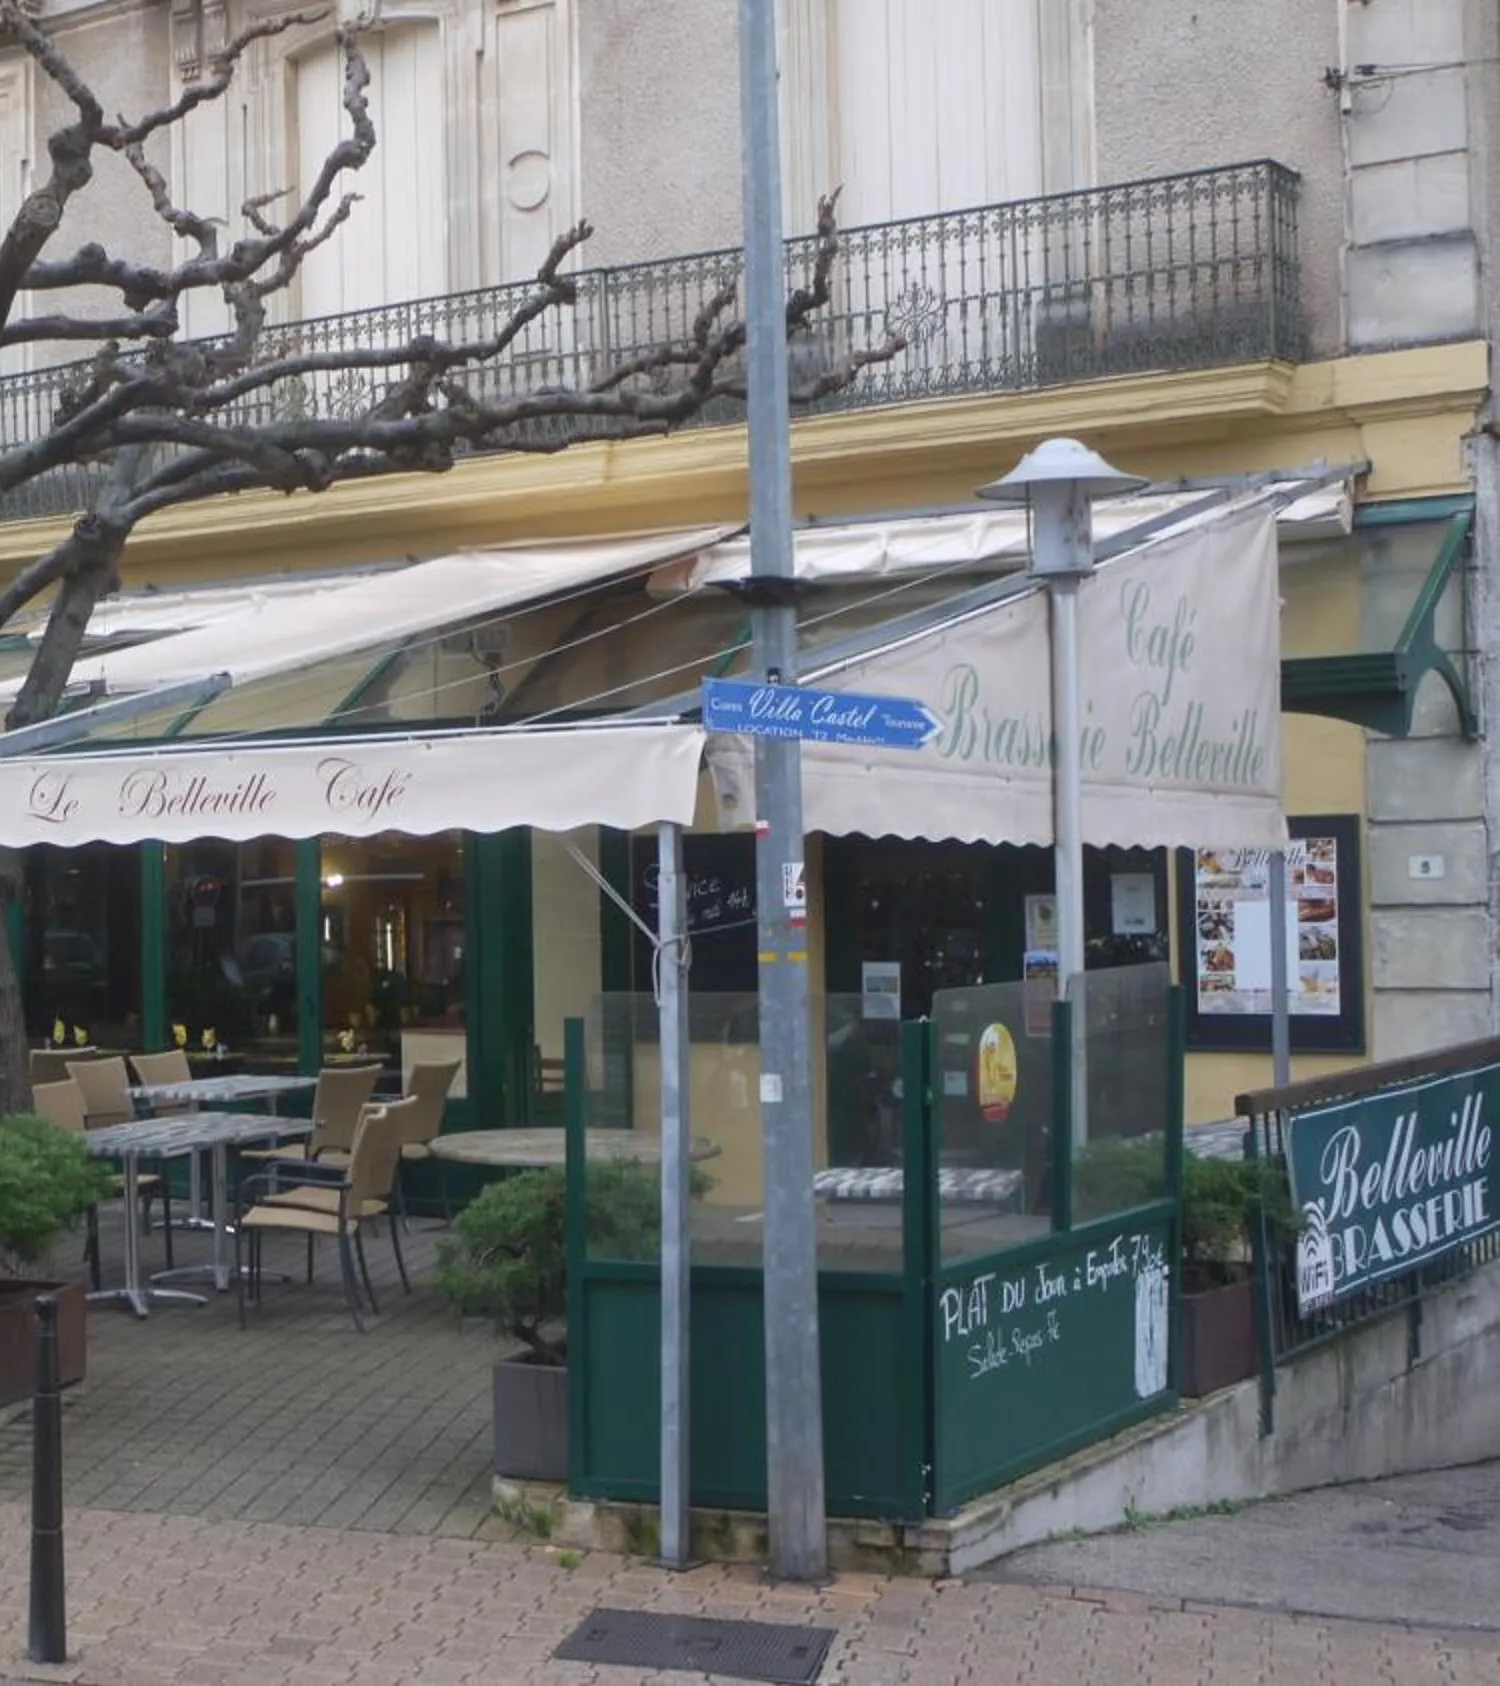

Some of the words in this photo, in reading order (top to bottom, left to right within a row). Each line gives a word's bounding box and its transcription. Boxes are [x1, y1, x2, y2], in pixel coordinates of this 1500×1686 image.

[1119, 578, 1197, 706] Café
[737, 723, 803, 738] LOCATION
[749, 687, 803, 721] Villa
[810, 694, 878, 729] Castel
[934, 663, 1107, 771] Brassie
[1126, 690, 1264, 785] Belleville
[28, 768, 79, 823] Le
[117, 766, 277, 820] Belleville
[315, 756, 413, 826] Café
[1320, 1090, 1492, 1225] Belleville
[1330, 1175, 1490, 1282] BRASSERIE
[939, 1272, 997, 1343] PLAT
[1001, 1277, 1026, 1314] DU
